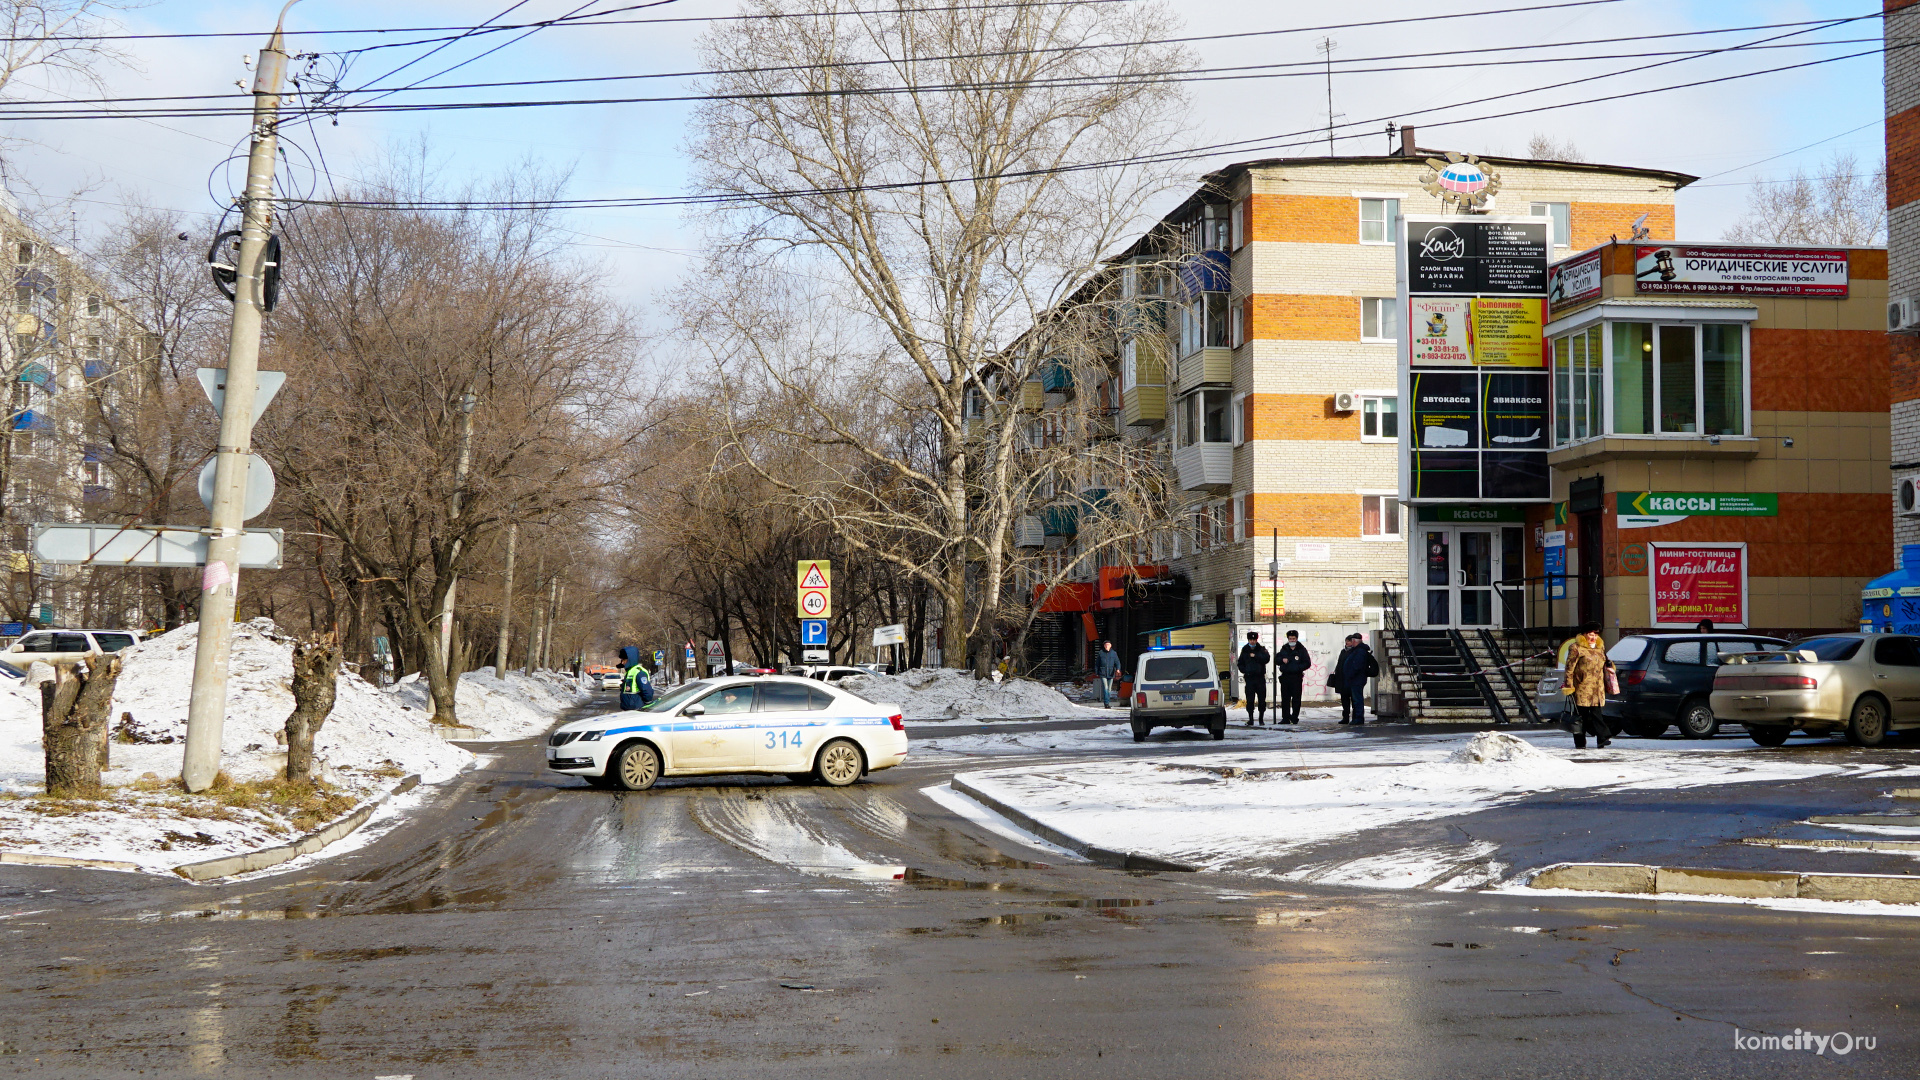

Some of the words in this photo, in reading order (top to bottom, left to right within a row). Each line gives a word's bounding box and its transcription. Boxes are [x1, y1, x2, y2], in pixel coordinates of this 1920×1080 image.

[1563, 260, 1599, 282] ЮРИДИЧЕСКИЕ
[1685, 259, 1788, 273] ЮРИДИЧЕСКИЕ
[1791, 261, 1844, 274] УСЛУГИ
[1572, 276, 1592, 291] УСЛУГИ
[1422, 396, 1471, 404] автокасса
[1493, 396, 1542, 404] авиакасса
[1650, 497, 1716, 511] кассы
[1453, 510, 1498, 519] кассы
[1657, 591, 1690, 600] 55-55-58
[807, 598, 822, 608] 40
[1667, 603, 1703, 614] Гагарина,
[1732, 604, 1737, 612] 5
[765, 731, 803, 749] 314
